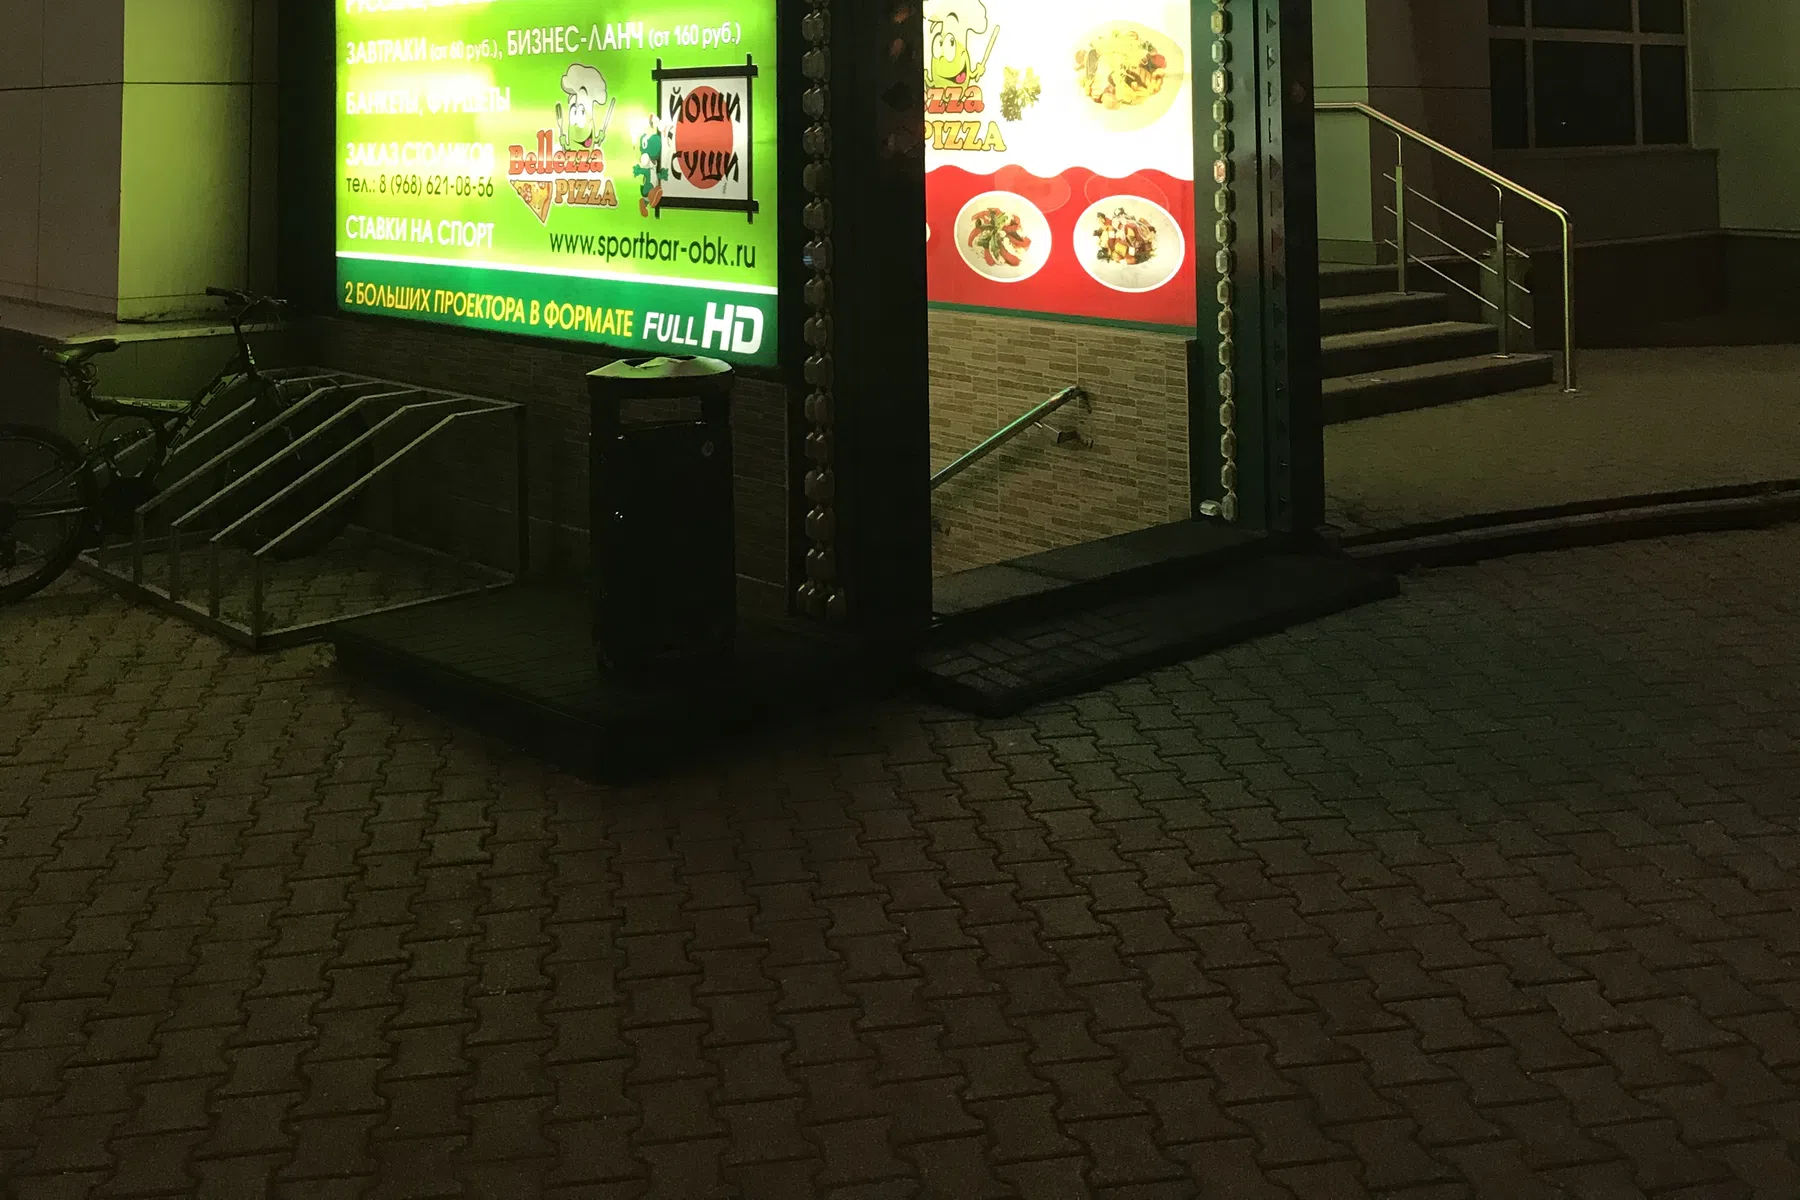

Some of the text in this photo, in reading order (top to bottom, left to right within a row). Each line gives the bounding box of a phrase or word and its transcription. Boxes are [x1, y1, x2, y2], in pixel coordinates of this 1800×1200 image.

[346, 36, 427, 65] ЗАВТРАКИ
[506, 21, 644, 56] БИЗНЕС-ЛАНЧ
[649, 28, 671, 50] (от
[674, 23, 699, 46] 160
[702, 21, 741, 49] руб.)
[669, 85, 742, 124] ЙОШИ
[925, 85, 985, 114] zza
[345, 141, 398, 167] ЗАКАЗ
[508, 129, 604, 176] Bellezza
[670, 150, 740, 184] СУШИ
[378, 173, 387, 194] 8
[390, 173, 422, 197] (968)
[426, 175, 495, 198] 621-08-56
[554, 178, 618, 207] PIZZA
[345, 214, 495, 249] СТАВКИ НА СПОРТ
[549, 231, 756, 269] www.sportbar-obk.ru
[345, 281, 764, 355] 2 БОЛЬШИХ ПРОЕКТОРА В ФОРМАТЕ FULL HD
